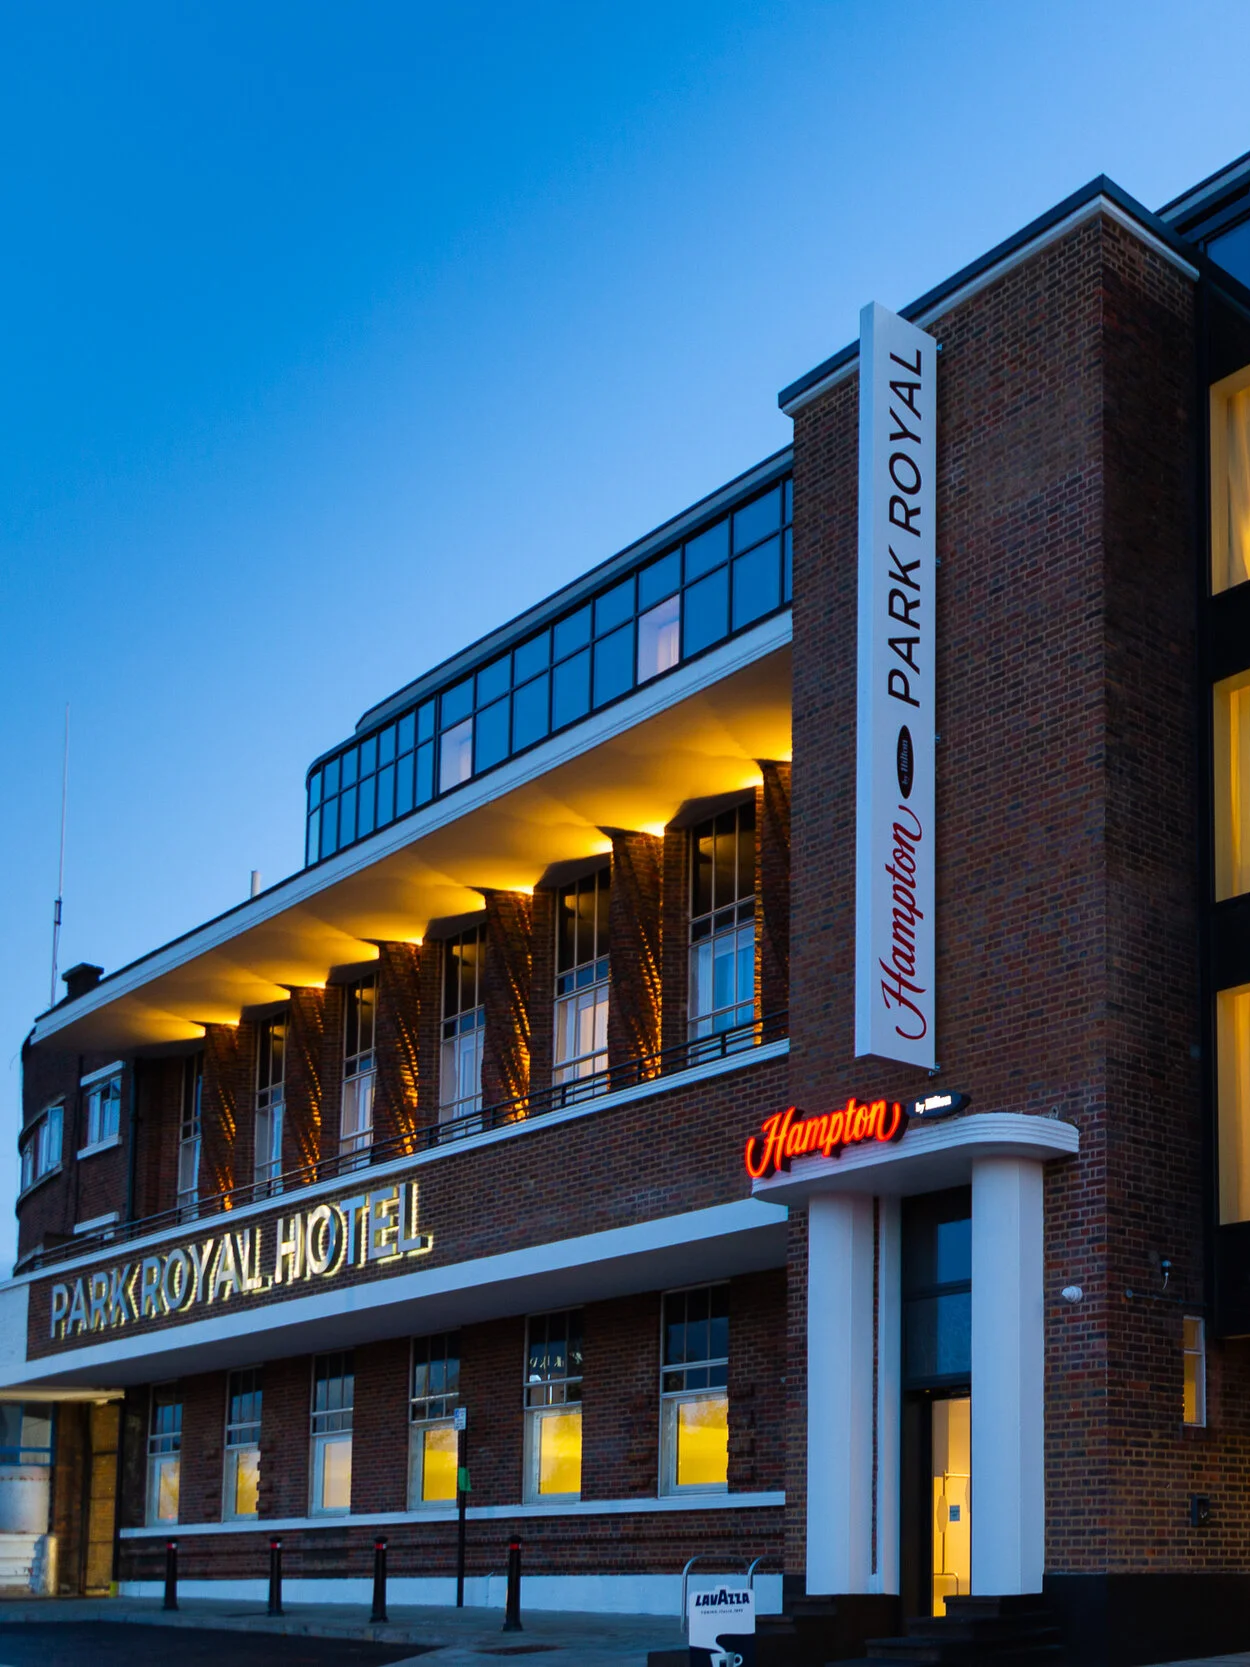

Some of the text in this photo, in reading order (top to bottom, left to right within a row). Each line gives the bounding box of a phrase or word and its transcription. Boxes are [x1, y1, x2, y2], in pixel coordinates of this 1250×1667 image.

[887, 349, 922, 708] PARK ROYAL
[900, 740, 909, 772] Hilton
[879, 804, 928, 1040] Hampton
[745, 1097, 902, 1178] Hampton
[51, 1183, 434, 1339] PARK ROYAL HOTEL
[695, 1589, 750, 1607] LAVAZZA
